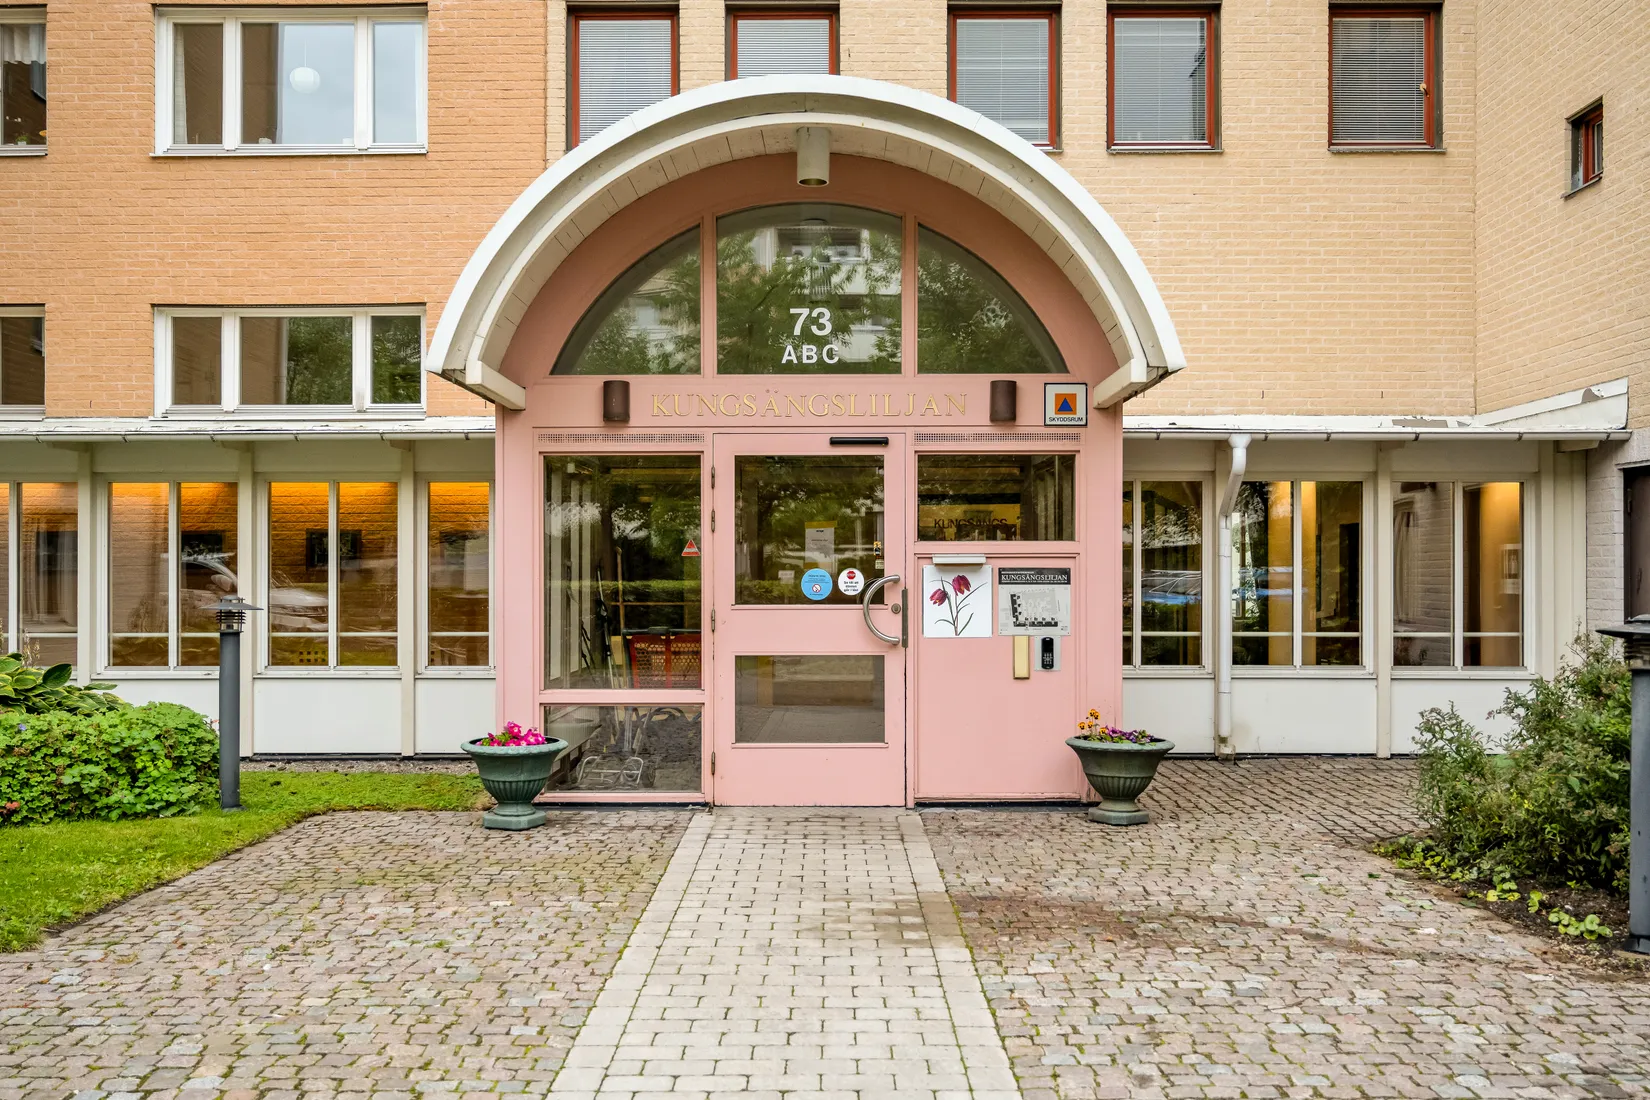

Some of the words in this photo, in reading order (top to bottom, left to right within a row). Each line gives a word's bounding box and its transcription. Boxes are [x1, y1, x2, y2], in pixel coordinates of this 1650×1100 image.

[789, 307, 833, 336] 73
[781, 344, 840, 364] ABC
[651, 388, 967, 417] KUNGSÄNGSLILJAN
[1001, 573, 1068, 581] KUNGSÄNGSLILJAN
